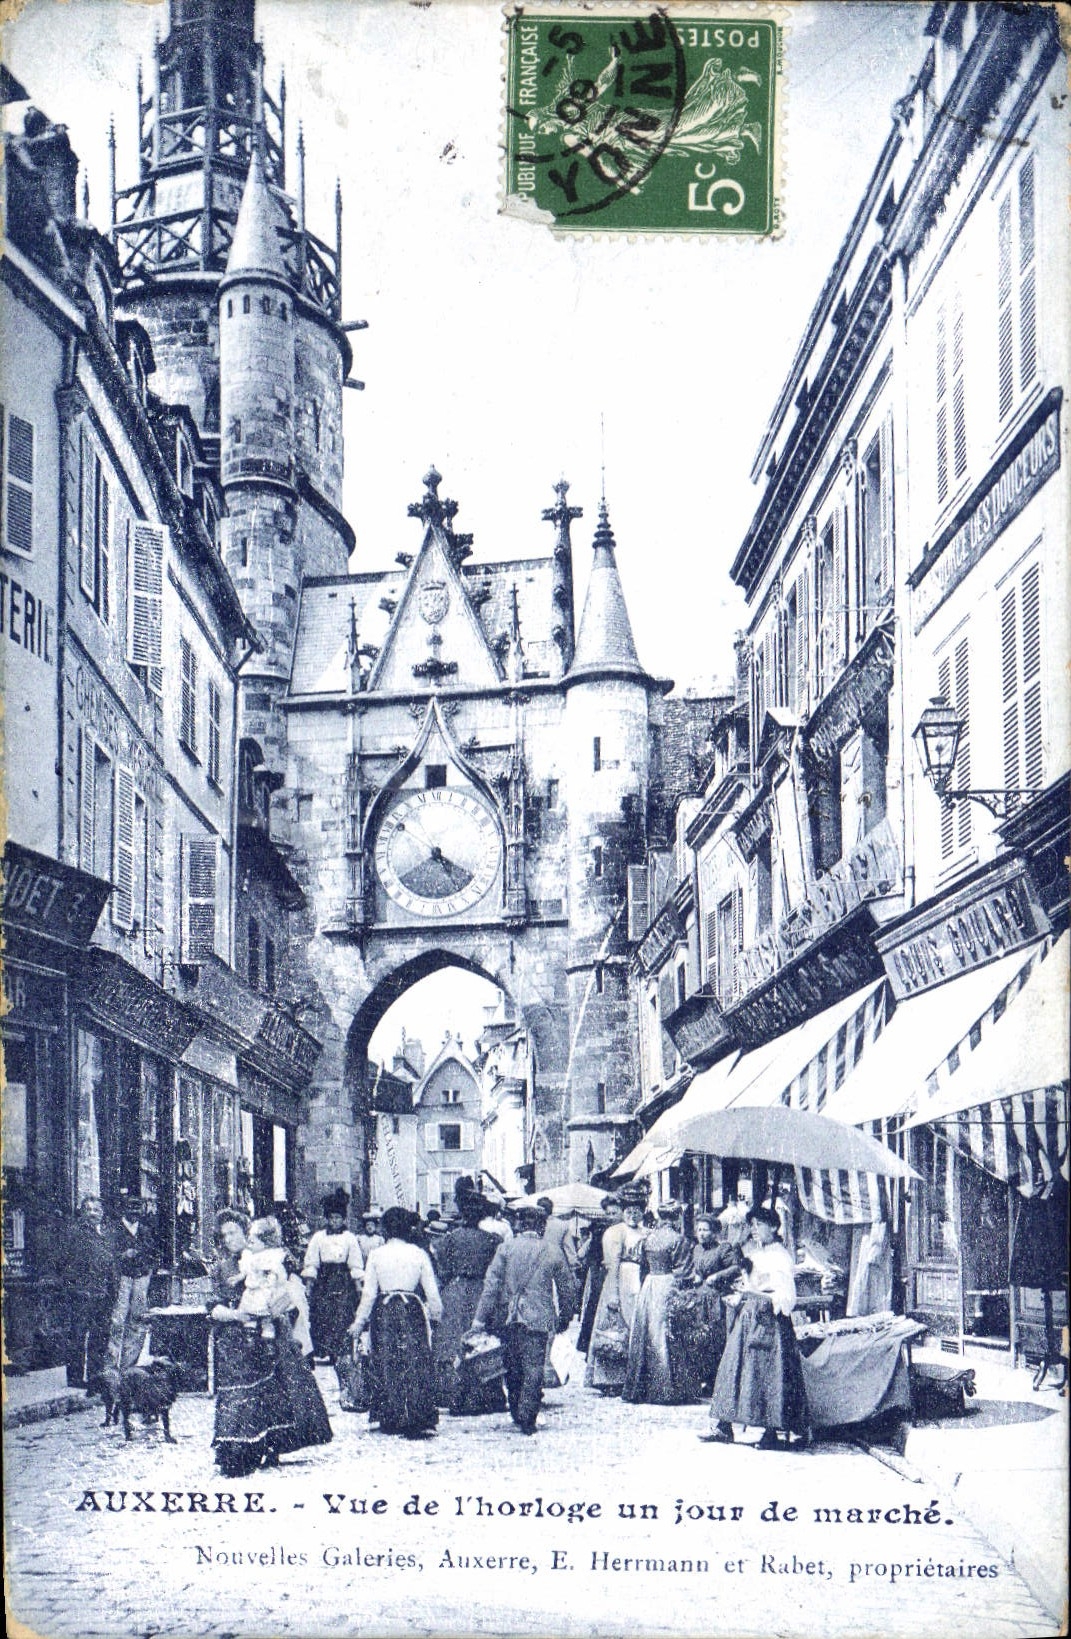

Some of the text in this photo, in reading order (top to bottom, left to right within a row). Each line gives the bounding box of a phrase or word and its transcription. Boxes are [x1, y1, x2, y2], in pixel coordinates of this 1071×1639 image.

[518, 25, 541, 105] FRANÇAISE
[677, 29, 760, 48] POSTES
[547, 12, 674, 203] YONNE
[990, 416, 1057, 525] DOUCEURS
